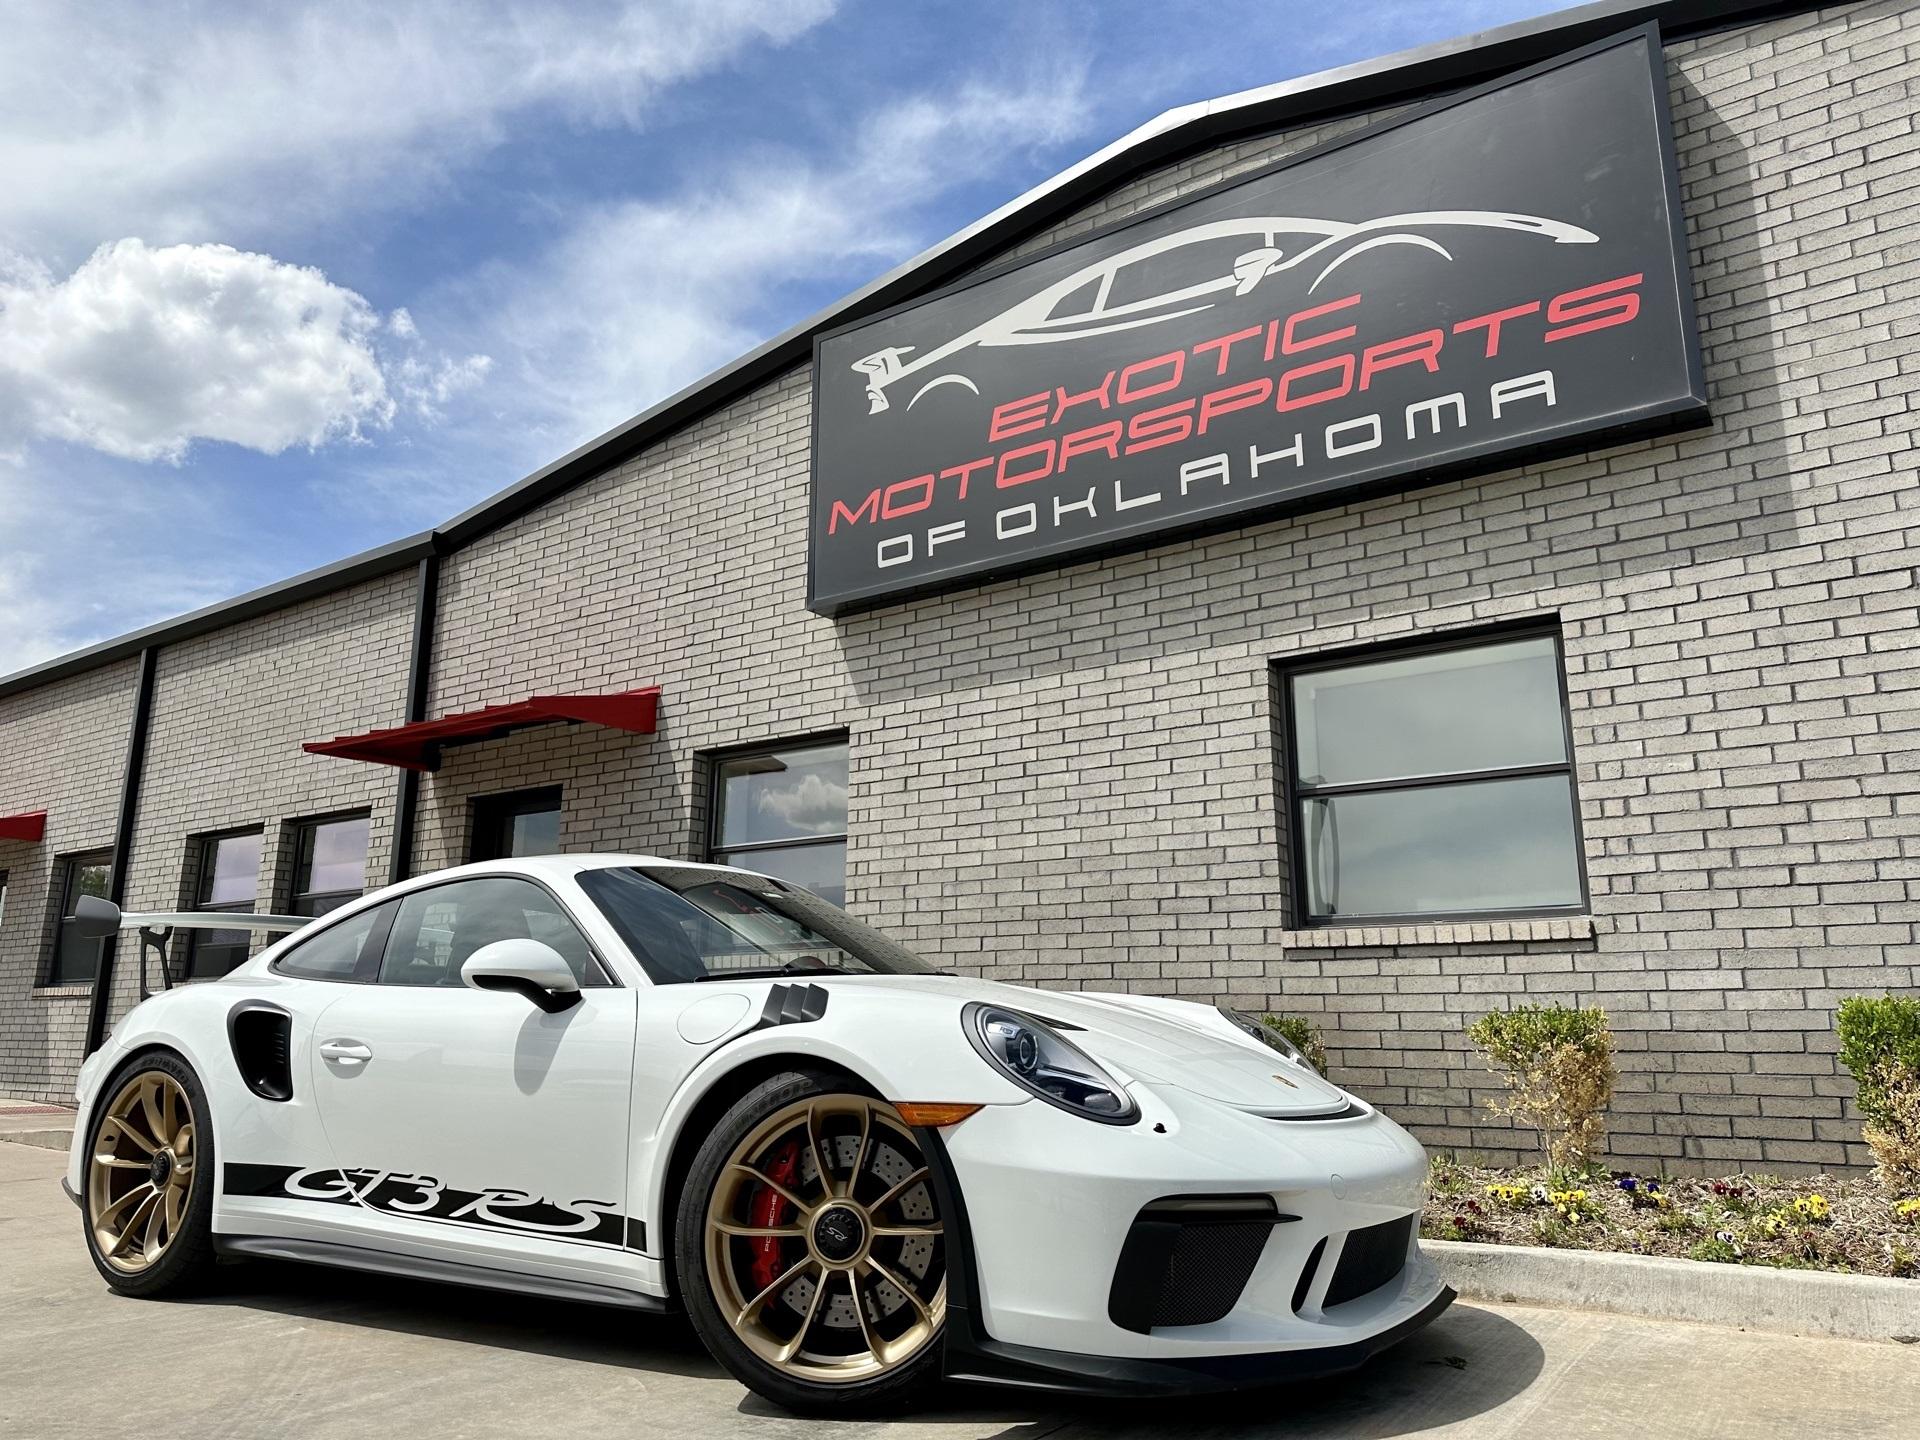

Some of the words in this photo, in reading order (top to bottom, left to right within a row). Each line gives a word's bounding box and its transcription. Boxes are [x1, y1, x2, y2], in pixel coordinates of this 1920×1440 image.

[828, 273, 1643, 533] MOTORSPORTS
[989, 294, 1361, 442] EXOTIC
[877, 519, 966, 569] OF
[995, 370, 1557, 540] OKLAHOMA
[284, 1167, 448, 1212] GT3
[448, 1188, 617, 1233] RS
[764, 1194, 778, 1252] POSCHE
